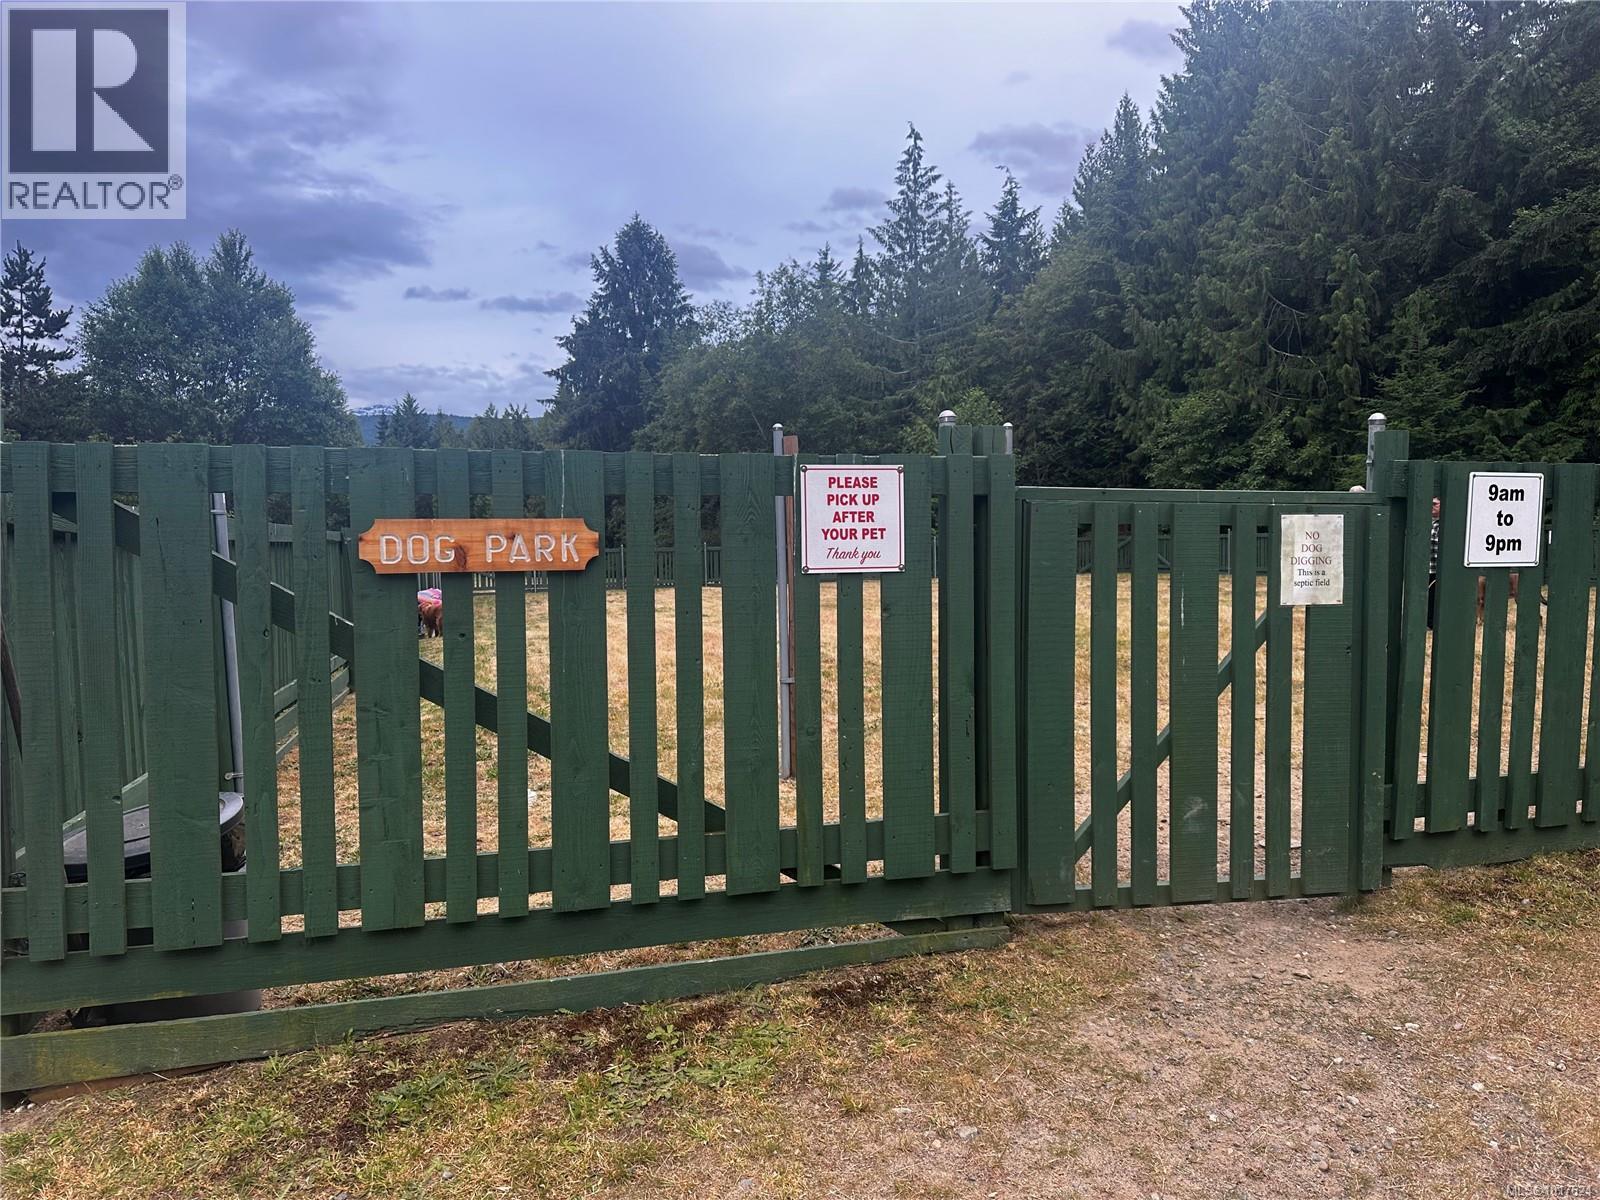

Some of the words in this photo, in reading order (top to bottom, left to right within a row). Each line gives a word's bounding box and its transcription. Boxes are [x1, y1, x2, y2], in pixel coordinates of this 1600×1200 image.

[828, 476, 878, 489] PLEASE
[826, 493, 858, 506] PICK
[862, 493, 880, 506] UP
[1488, 484, 1525, 502] 9am
[832, 511, 875, 523] AFTER
[1496, 510, 1514, 527] to
[821, 528, 858, 541] YOUR
[861, 527, 887, 540] PET
[1305, 530, 1320, 541] NO
[380, 535, 456, 565] DOG
[485, 532, 580, 563] PARK
[1301, 543, 1323, 553] DOG
[1485, 534, 1522, 556] 9pm
[826, 547, 860, 560] Thank
[860, 550, 882, 565] you
[1290, 556, 1333, 566] DIGGING
[1297, 568, 1313, 576] This
[1314, 568, 1321, 576] is
[1293, 580, 1314, 589] septic
[1315, 578, 1330, 587] field
